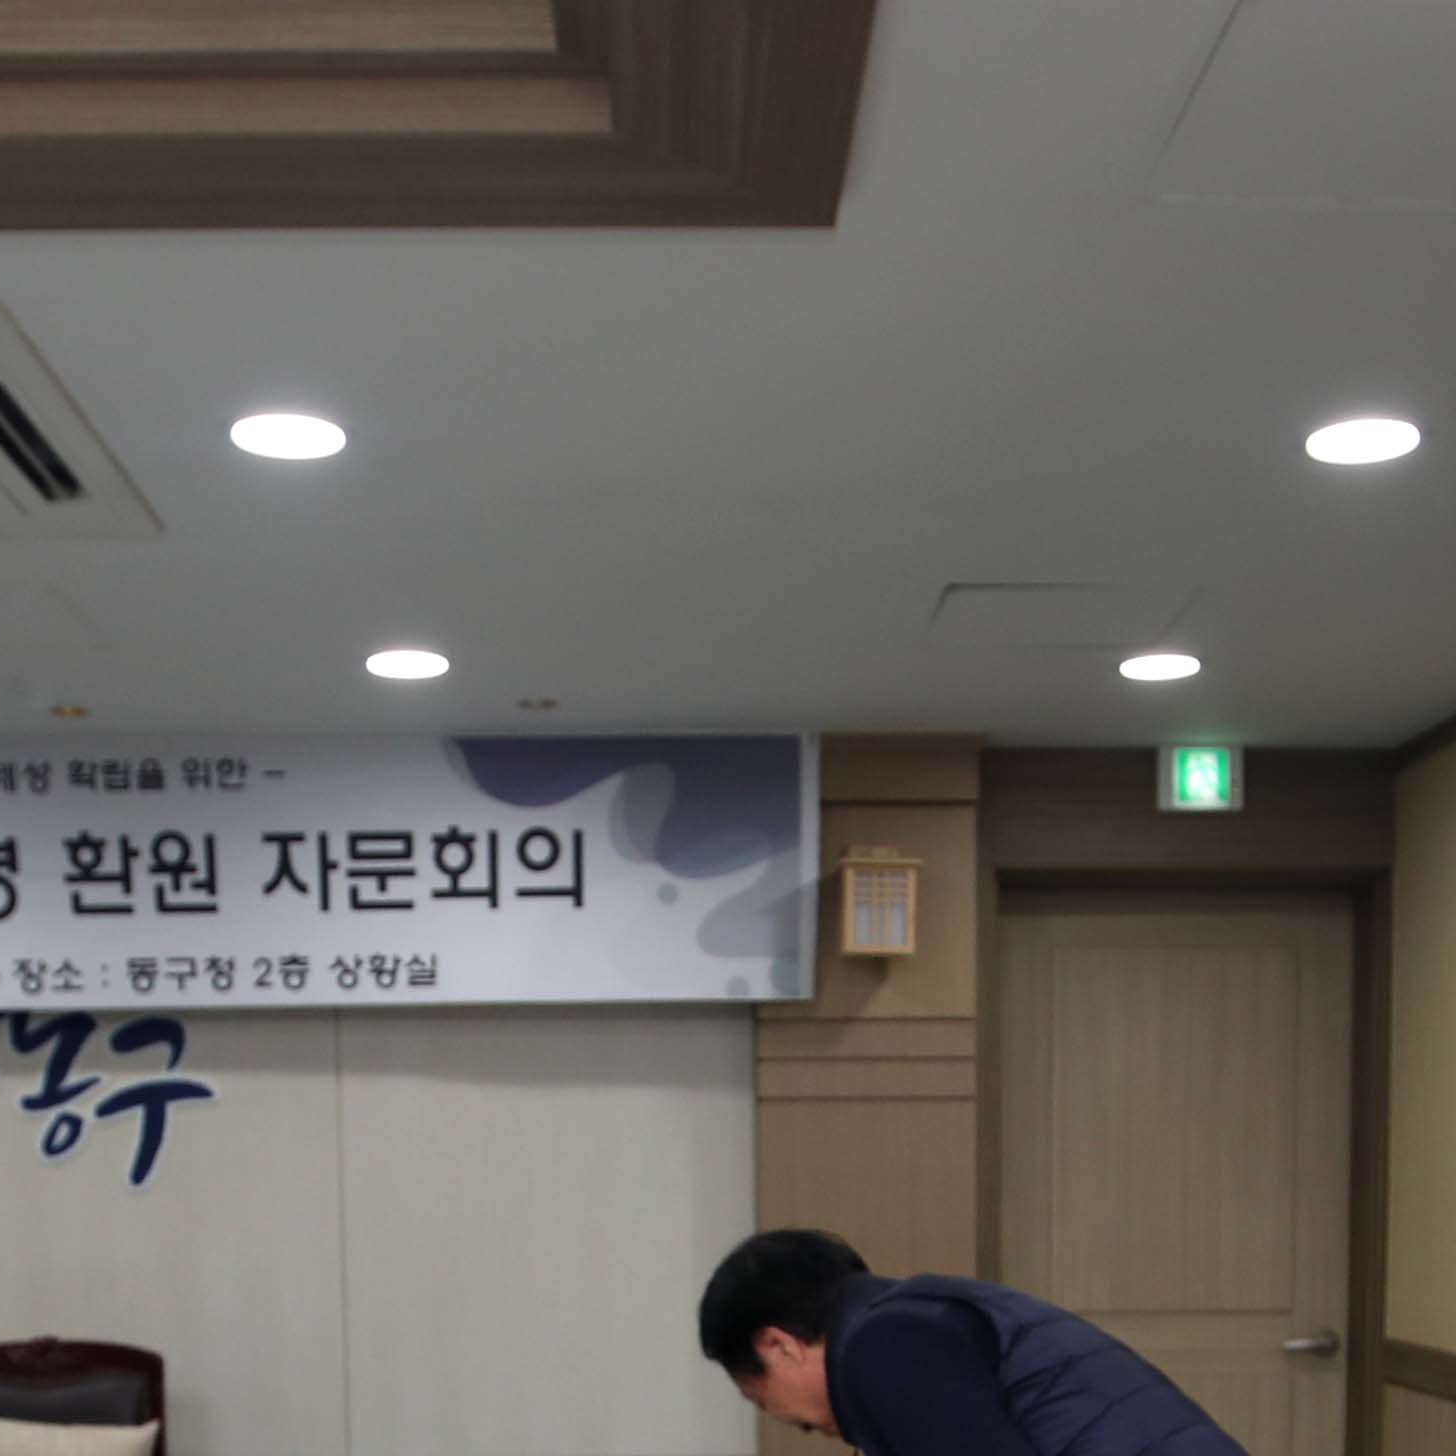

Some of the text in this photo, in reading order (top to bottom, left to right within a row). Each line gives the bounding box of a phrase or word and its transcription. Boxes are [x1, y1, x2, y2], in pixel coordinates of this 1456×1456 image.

[67, 758, 167, 793] 확립을
[181, 757, 247, 791] 위한
[61, 830, 221, 915] 환원
[260, 826, 585, 913] 자문회의
[11, 957, 85, 996] 장소
[127, 953, 236, 994] 동구청
[253, 953, 311, 991] 2층
[328, 951, 439, 990] 상황실
